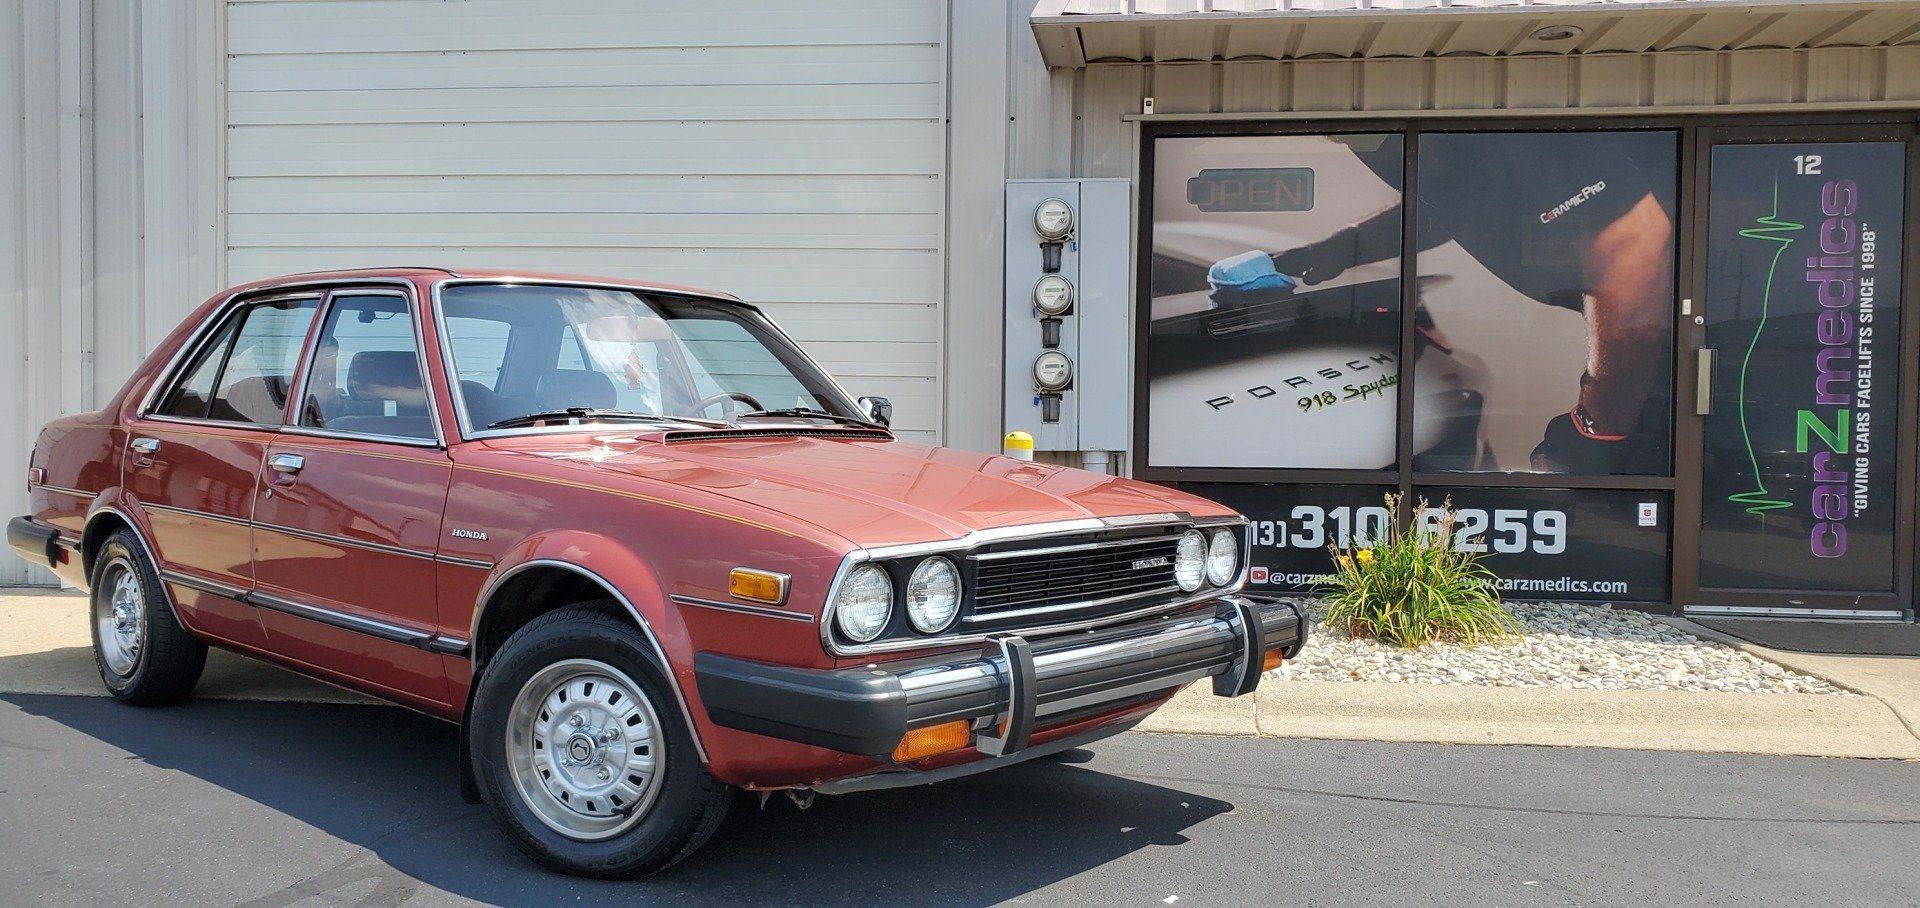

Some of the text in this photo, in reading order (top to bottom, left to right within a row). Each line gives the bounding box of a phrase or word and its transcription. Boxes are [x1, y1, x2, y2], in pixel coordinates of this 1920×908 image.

[1793, 155, 1822, 175] 12
[1188, 177, 1303, 206] OPEN
[1859, 277, 1874, 324] SINCE
[1857, 326, 1873, 408] FACELIFTS
[1297, 390, 1337, 413] 918
[1856, 411, 1870, 454] CARS
[452, 528, 487, 541] HONDA
[1291, 505, 1391, 550] 310
